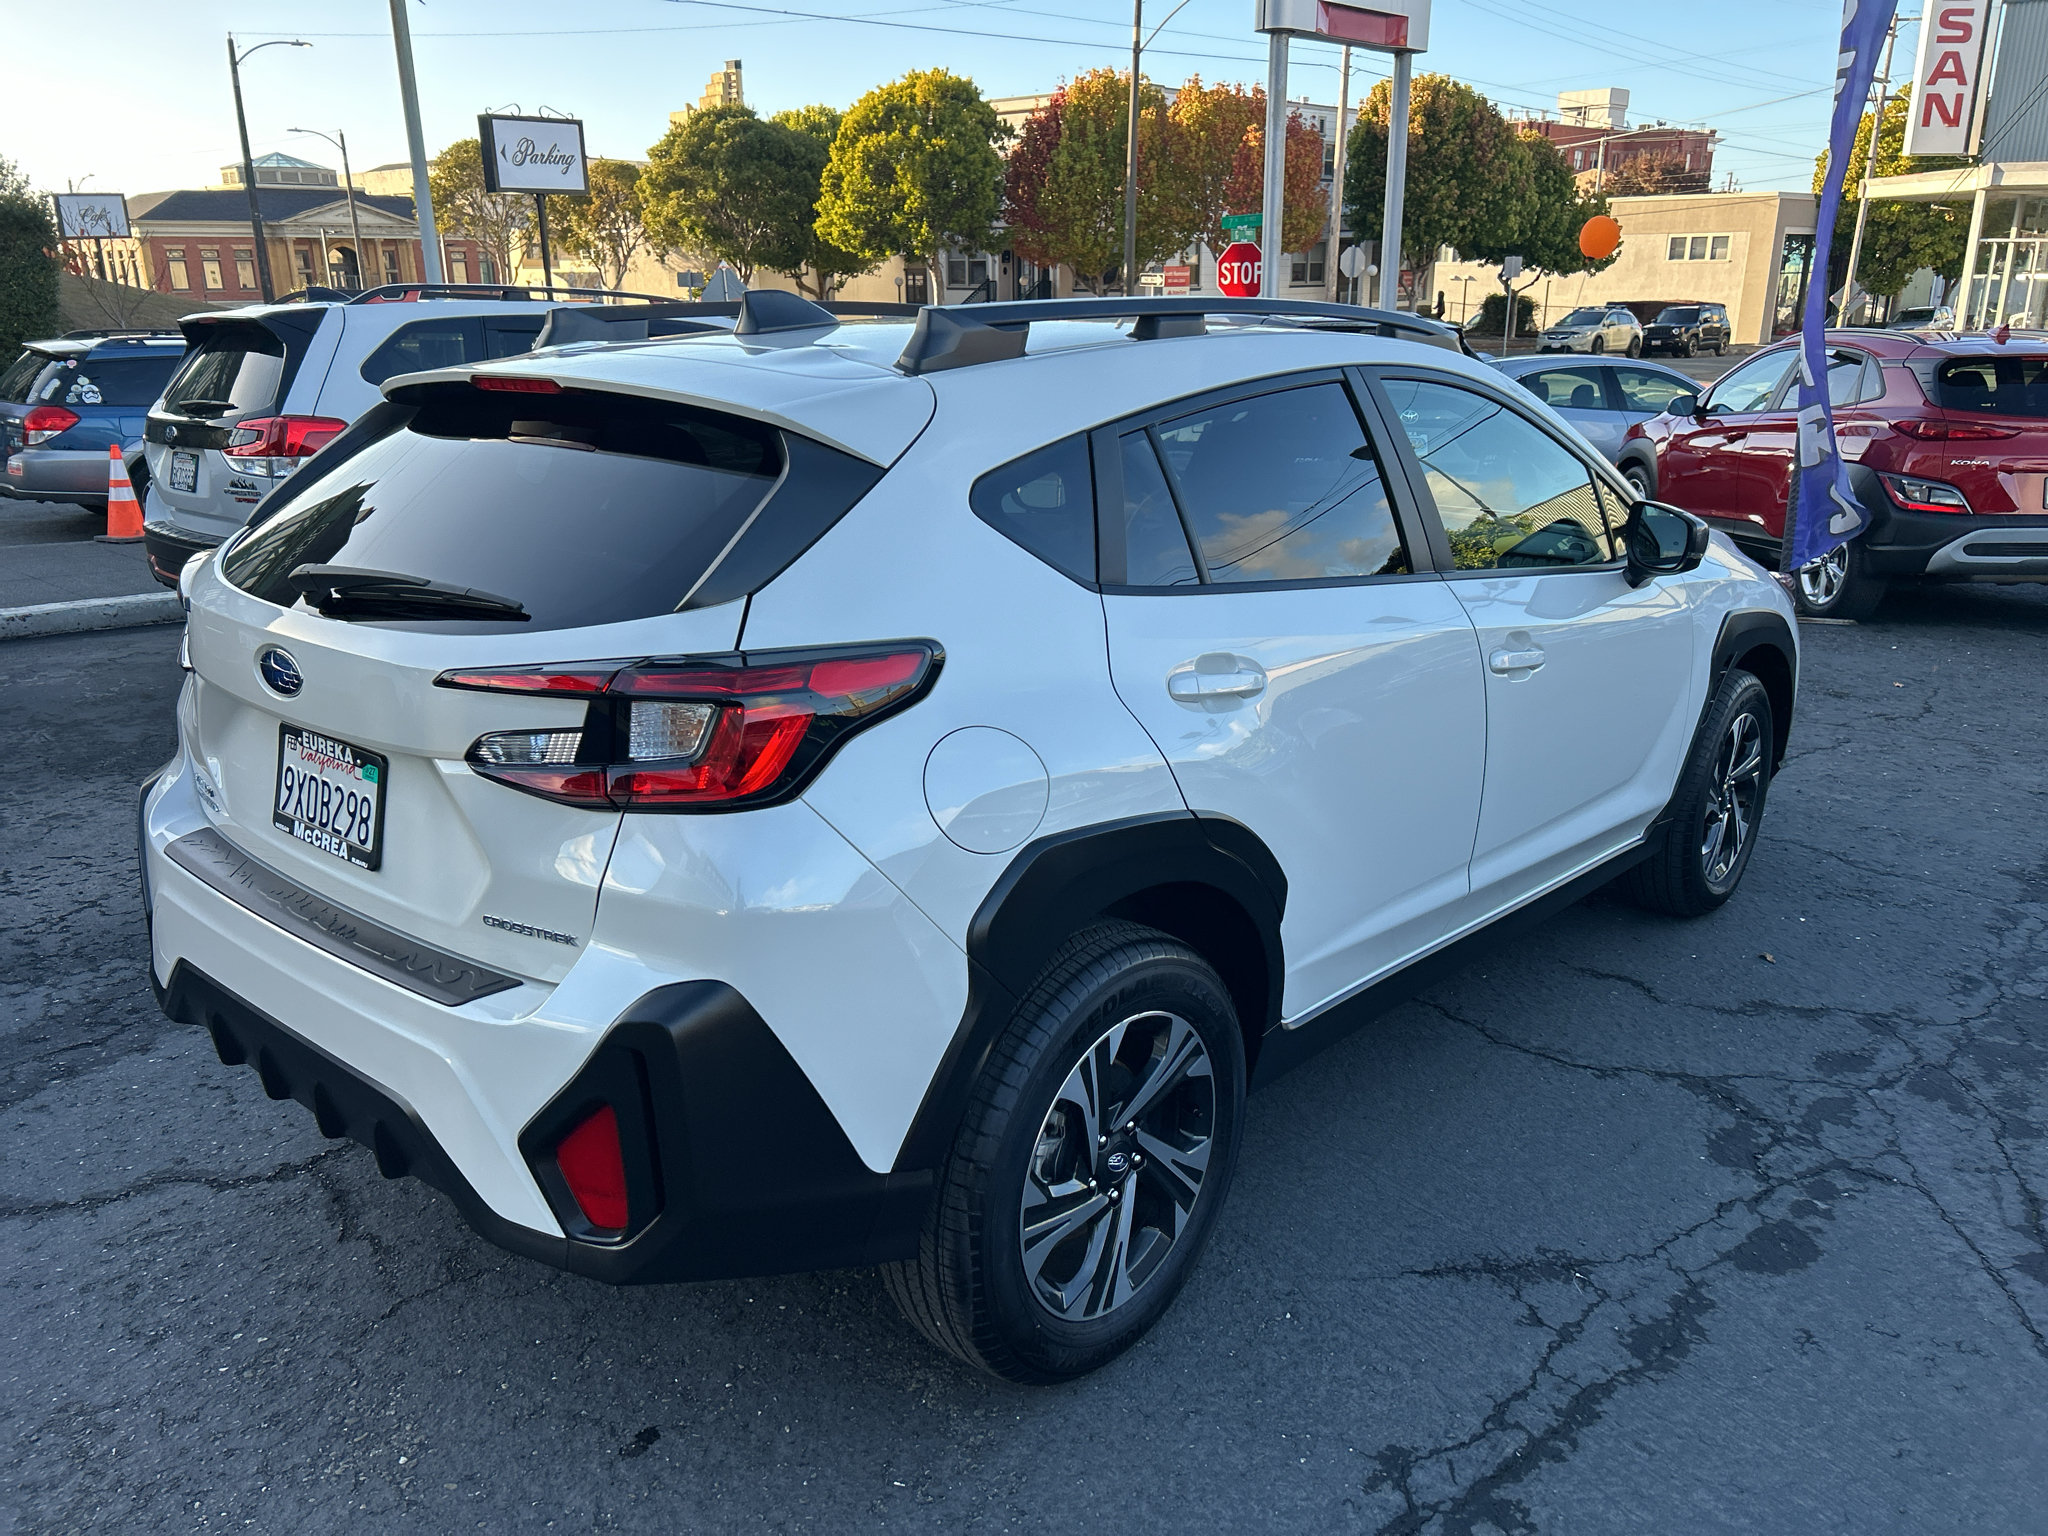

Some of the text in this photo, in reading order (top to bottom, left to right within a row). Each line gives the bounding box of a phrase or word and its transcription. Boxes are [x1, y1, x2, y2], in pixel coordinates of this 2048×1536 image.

[1921, 0, 1976, 128] SAN
[512, 137, 577, 175] Parking
[302, 731, 354, 764] EUREKA
[293, 820, 349, 860] McCREA
[482, 914, 580, 948] CROSSTREK
